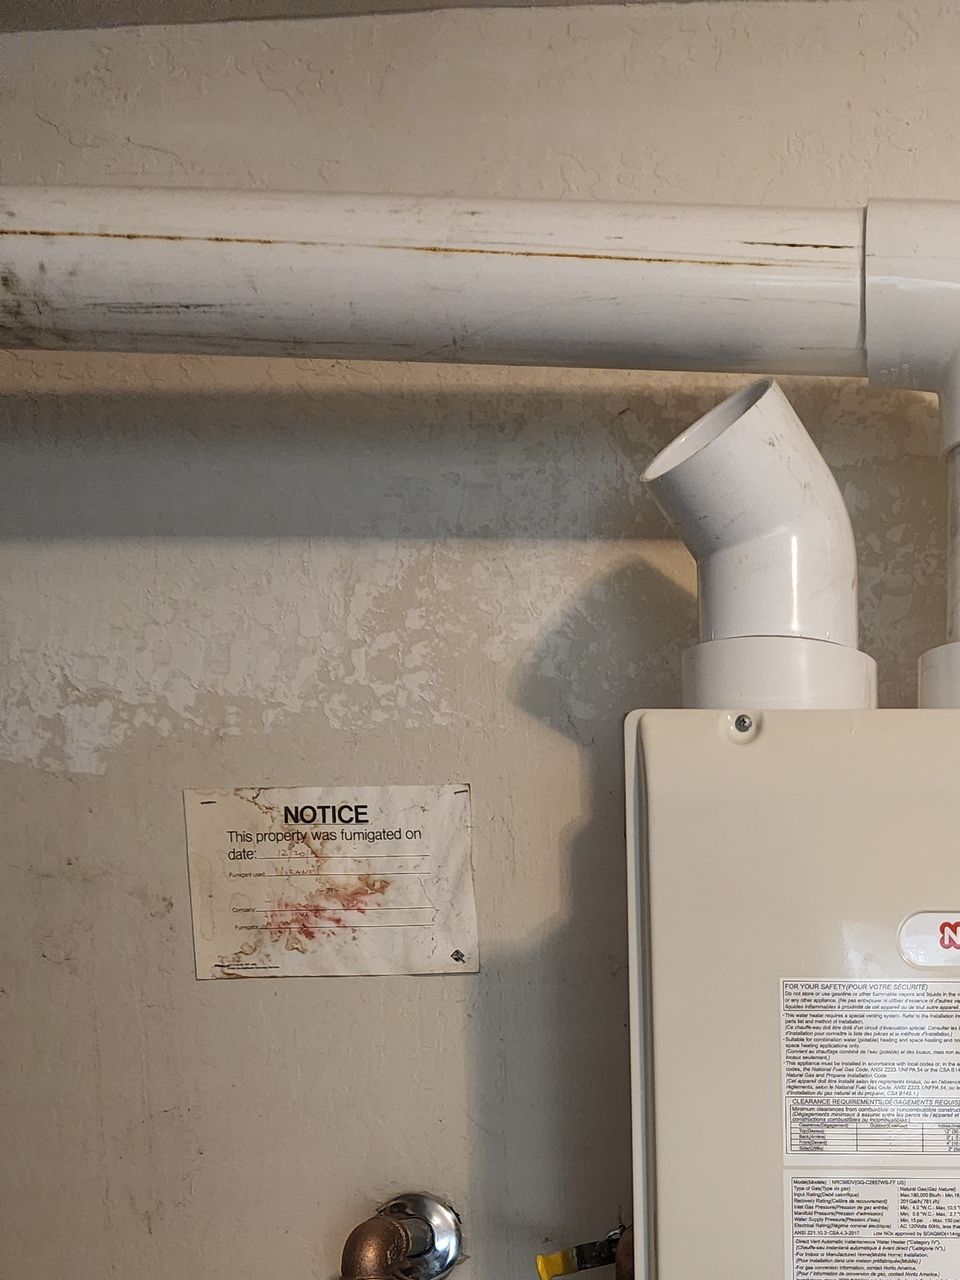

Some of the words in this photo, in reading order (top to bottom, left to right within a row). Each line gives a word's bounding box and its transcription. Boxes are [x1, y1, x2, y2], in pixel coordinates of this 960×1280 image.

[283, 805, 369, 824] NOTICE
[227, 831, 252, 843] This
[256, 832, 306, 844] property
[311, 832, 336, 841] was
[341, 828, 401, 842] fumigated
[406, 829, 422, 840] on
[228, 849, 257, 860] date:
